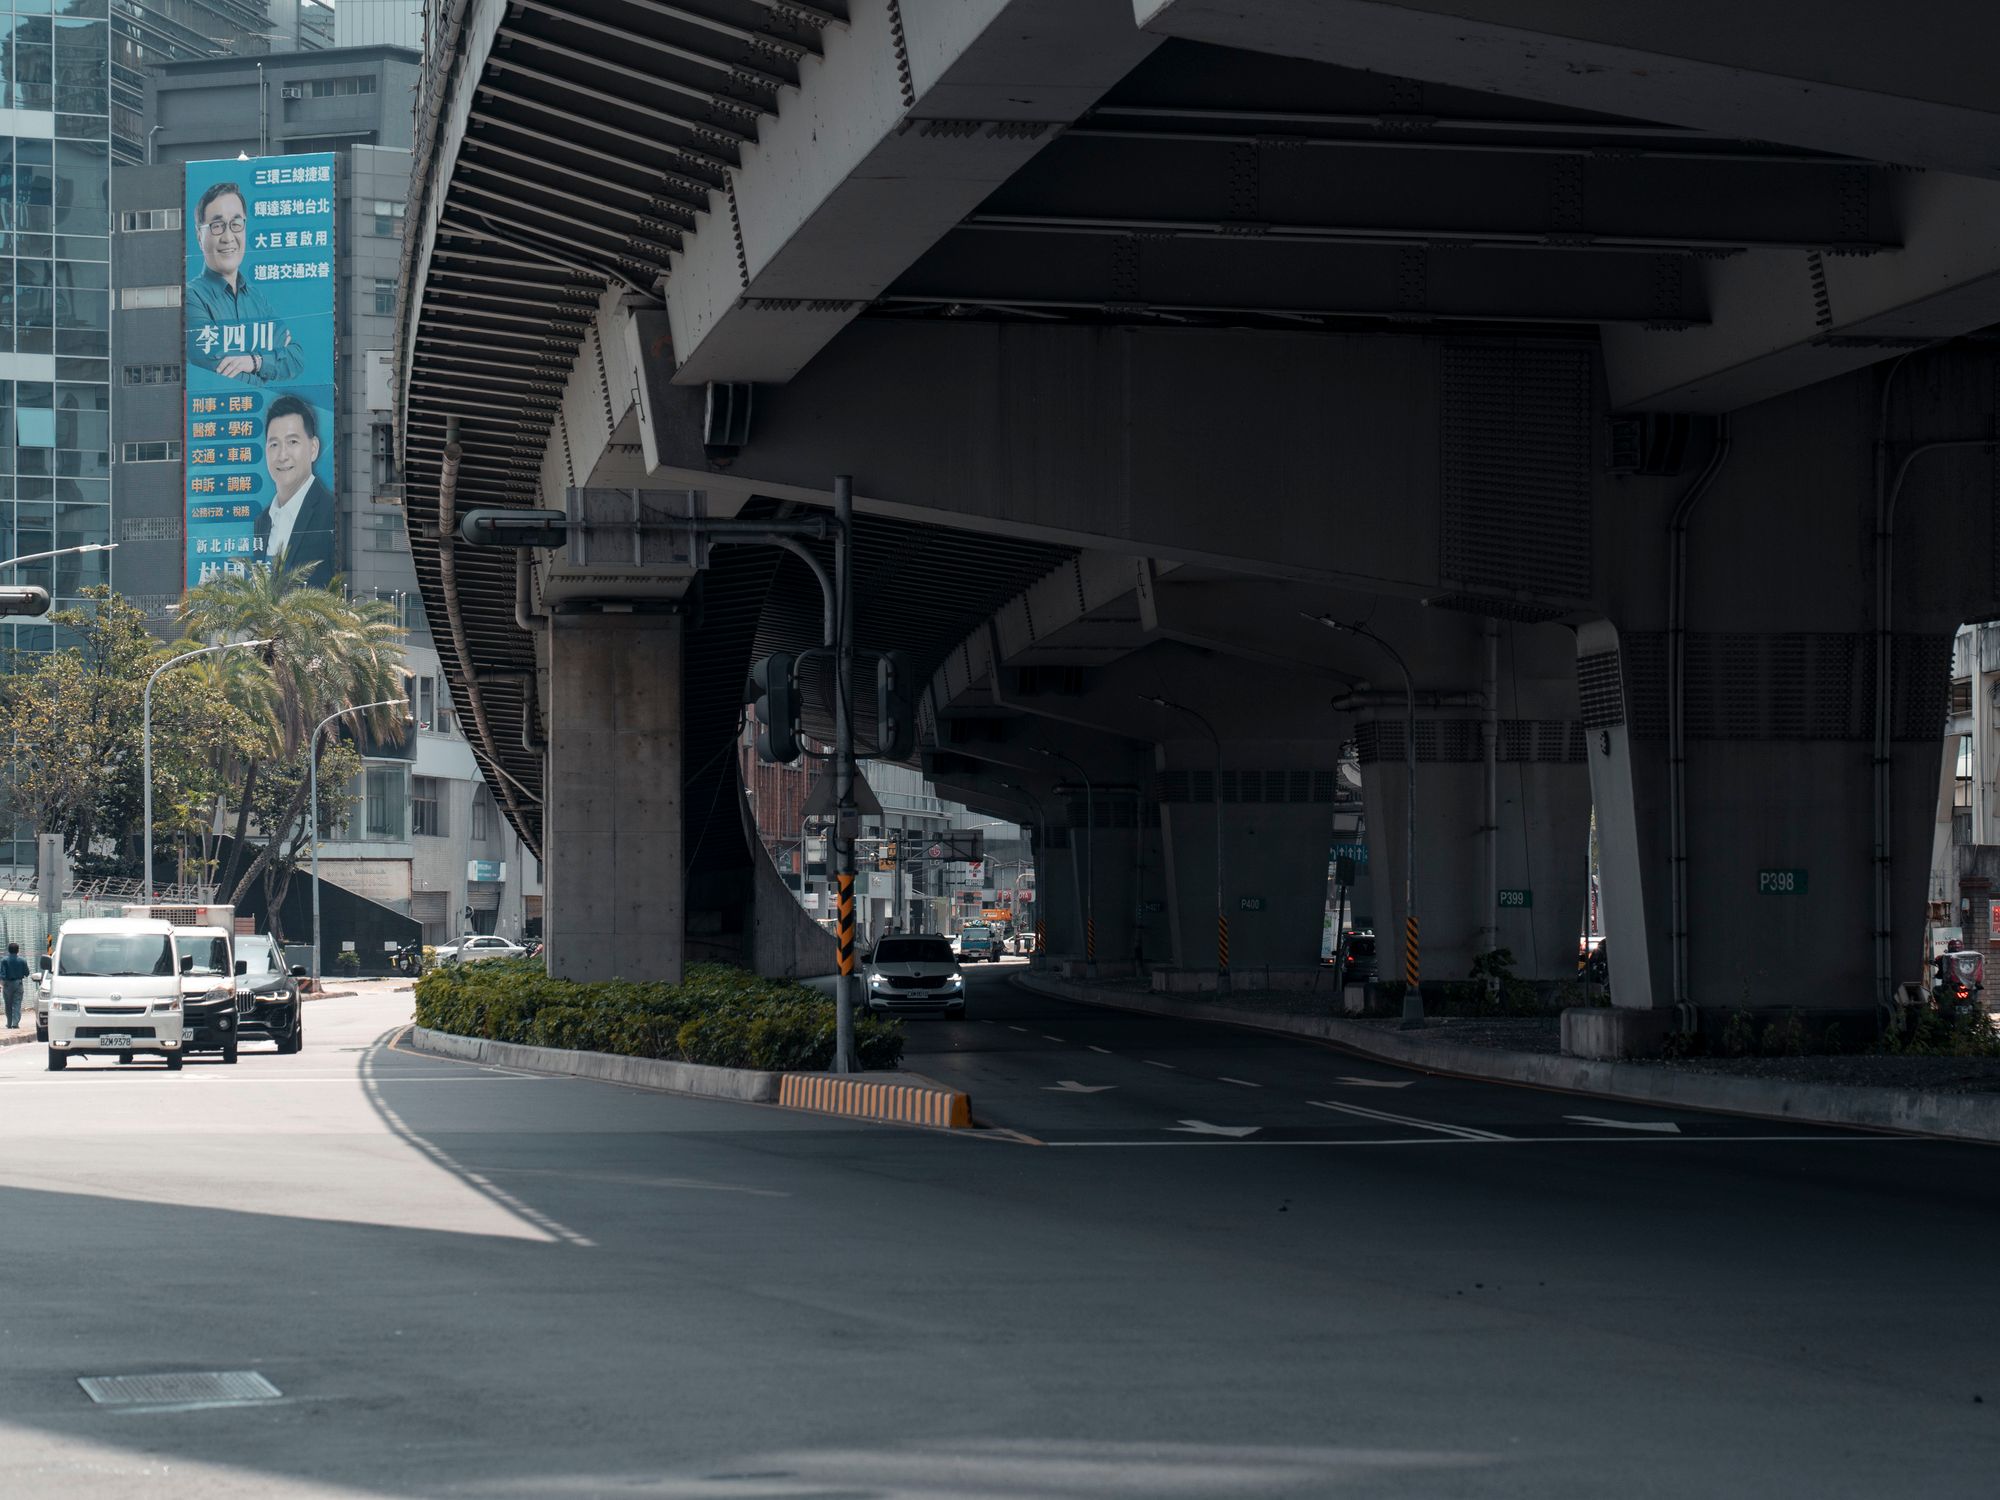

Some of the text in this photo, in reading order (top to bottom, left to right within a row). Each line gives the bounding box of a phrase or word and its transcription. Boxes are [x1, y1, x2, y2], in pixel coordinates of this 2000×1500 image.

[255, 166, 331, 185] 三環三線捷運
[254, 198, 330, 217] 輝達落地台北
[255, 231, 328, 248] 大巨蛋啟用
[254, 263, 330, 281] 道路交通改善
[195, 321, 274, 355] 李四川
[196, 537, 264, 554] 新北市議員
[1760, 872, 1795, 891] P398
[1241, 898, 1261, 911] P400
[1500, 891, 1524, 905] P399
